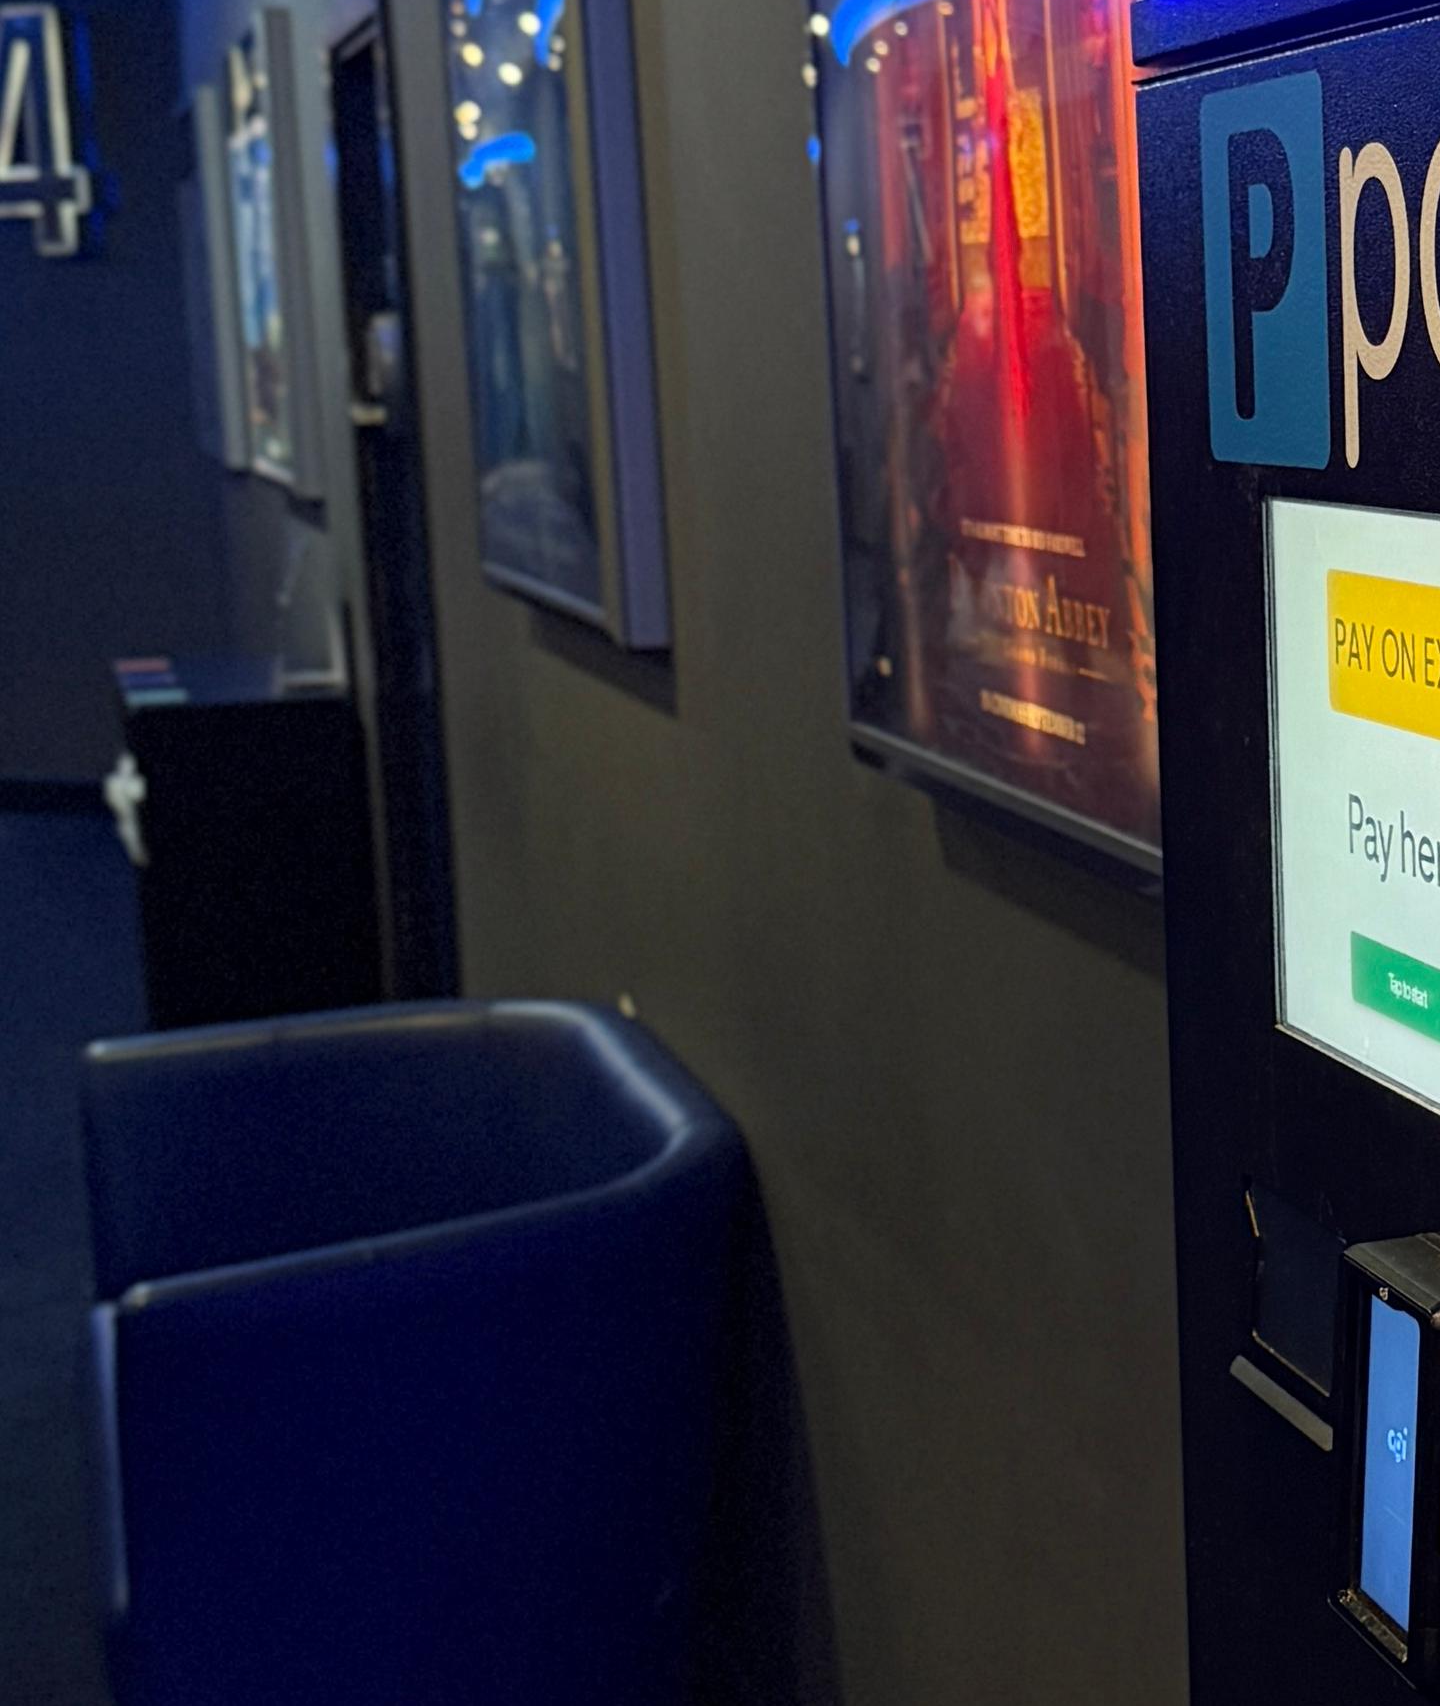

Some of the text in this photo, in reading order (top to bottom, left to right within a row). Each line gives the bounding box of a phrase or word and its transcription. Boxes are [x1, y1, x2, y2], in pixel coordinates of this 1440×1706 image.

[0, 0, 93, 256] 4
[1335, 617, 1375, 672] PAY
[1381, 628, 1416, 683] ON
[1348, 793, 1393, 883] Pay
